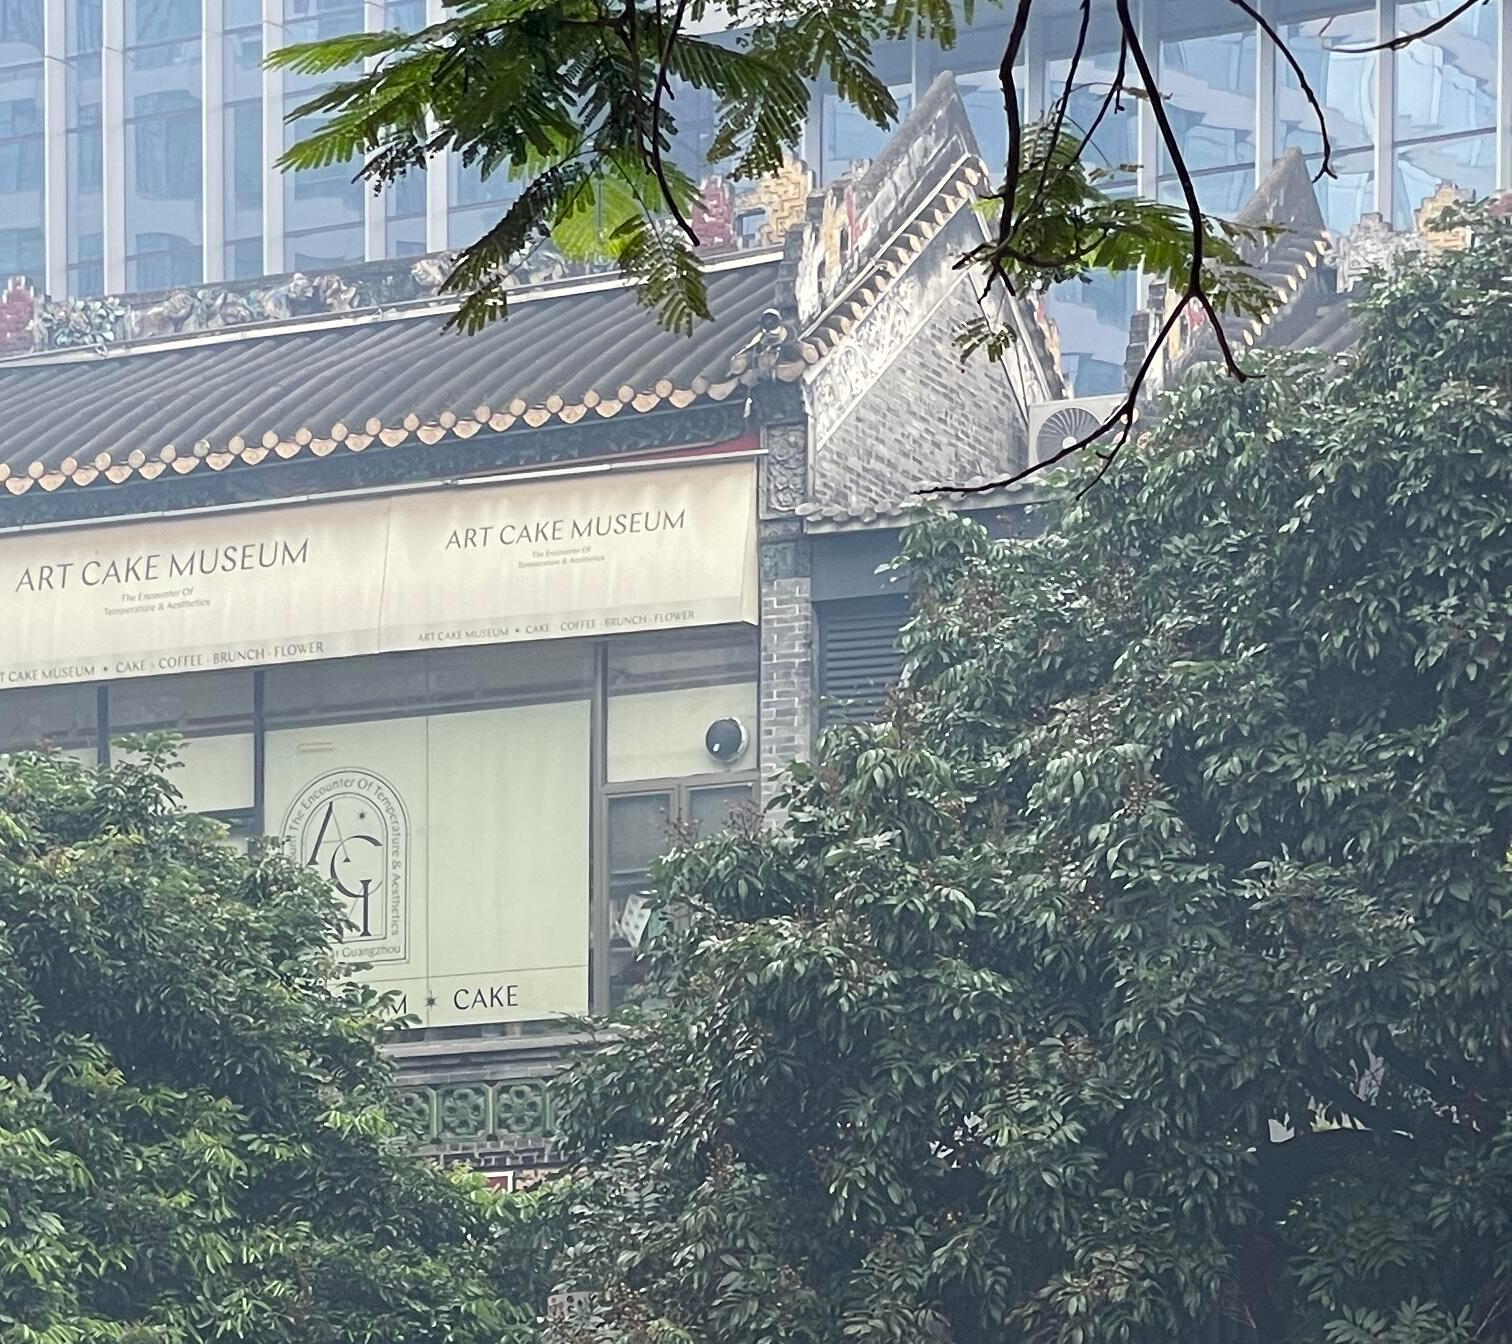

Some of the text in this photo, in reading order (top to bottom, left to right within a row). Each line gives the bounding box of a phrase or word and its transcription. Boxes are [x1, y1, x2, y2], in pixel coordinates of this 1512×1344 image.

[444, 509, 685, 550] ART CAKE MUSEUM
[15, 538, 309, 592] ART CAKE MUSEUM
[417, 610, 695, 643] ART CAKE MUSEUM CAKE COFFEE BRUNCH FLOWER
[8, 669, 38, 683] CAKE
[41, 665, 95, 680] MUSEUM
[115, 659, 146, 674] CAKE
[158, 654, 203, 670] COFFEE
[213, 647, 265, 666] BRUNCH
[274, 640, 325, 659] FLOWER
[301, 777, 356, 811] Encounter
[357, 777, 373, 793] Of
[288, 815, 303, 838] The
[373, 788, 401, 849] Temperature
[393, 860, 402, 872] &
[390, 873, 402, 937] Aesthetics
[341, 944, 402, 960] Guangzhou
[453, 985, 519, 1010] CAKE
